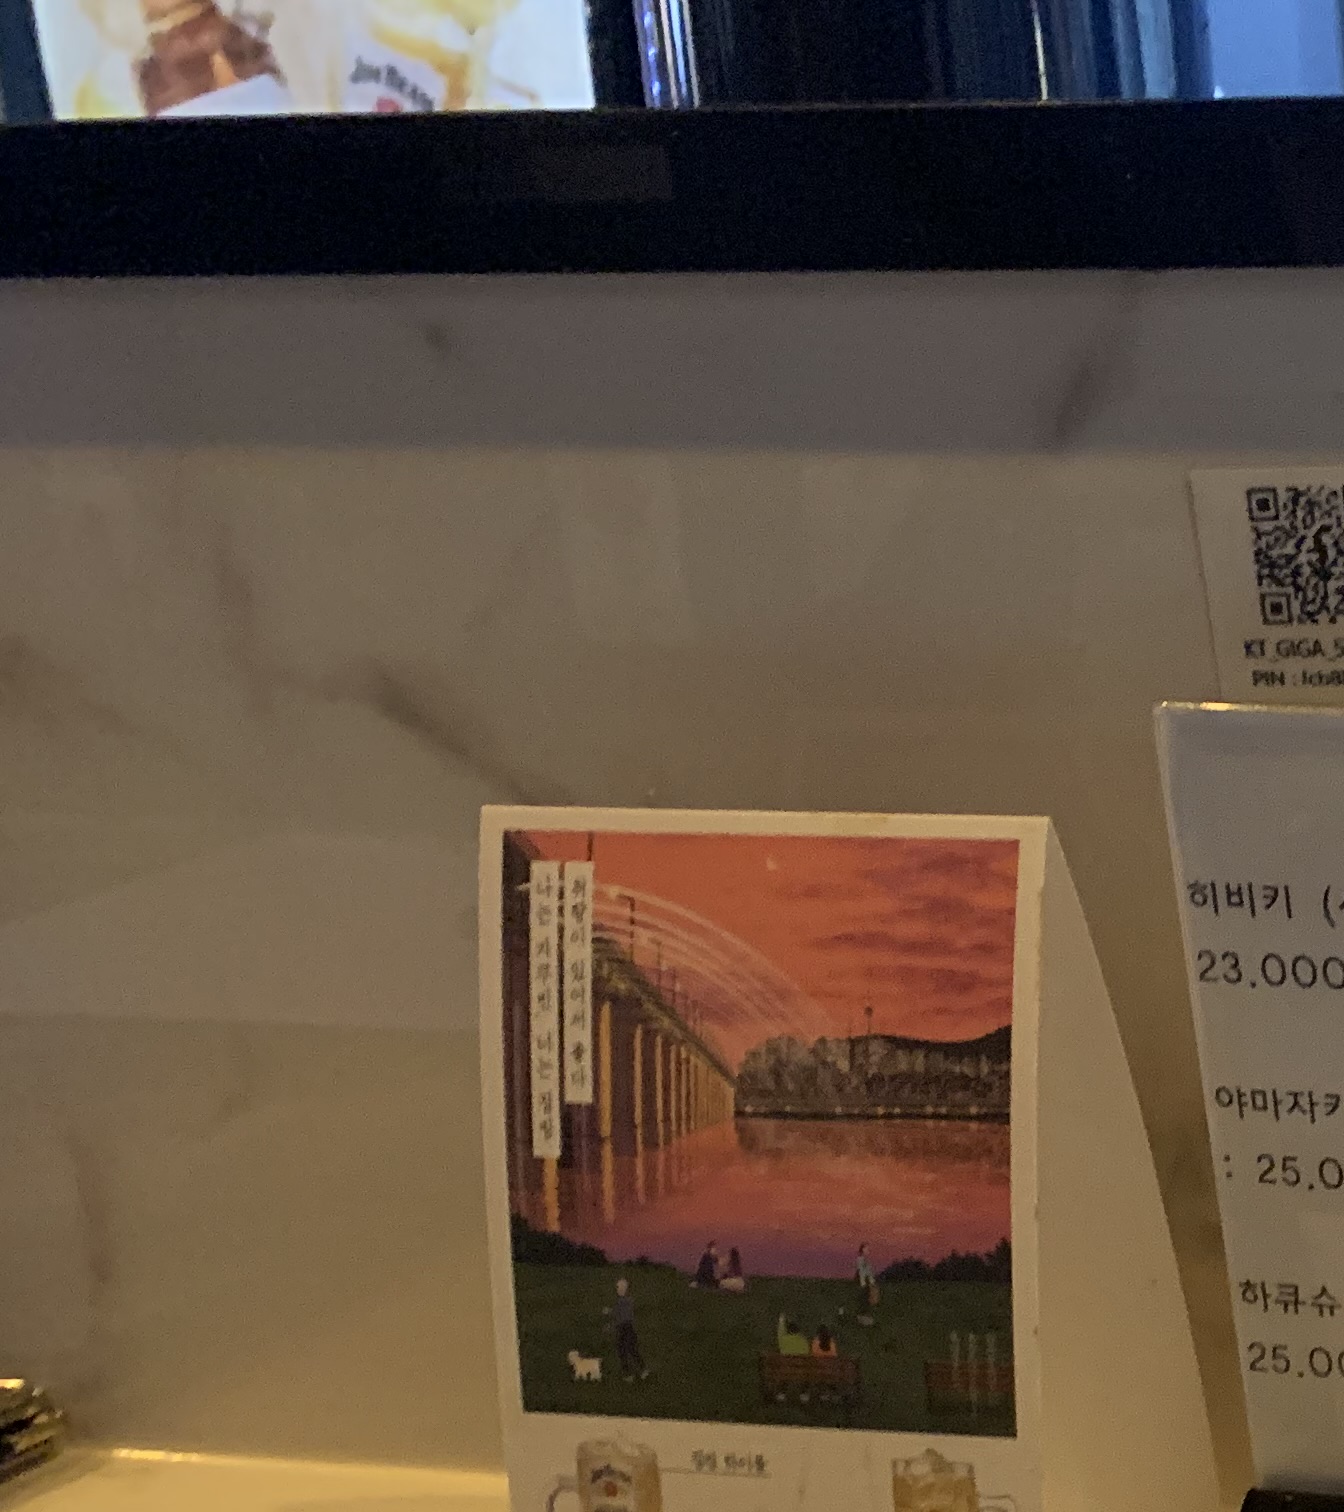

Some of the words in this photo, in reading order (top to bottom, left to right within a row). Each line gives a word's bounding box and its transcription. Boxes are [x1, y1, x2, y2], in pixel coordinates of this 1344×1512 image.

[1252, 669, 1285, 687] PIN
[1188, 880, 1293, 919] 히비키
[1240, 1279, 1342, 1319] 하큐슈
